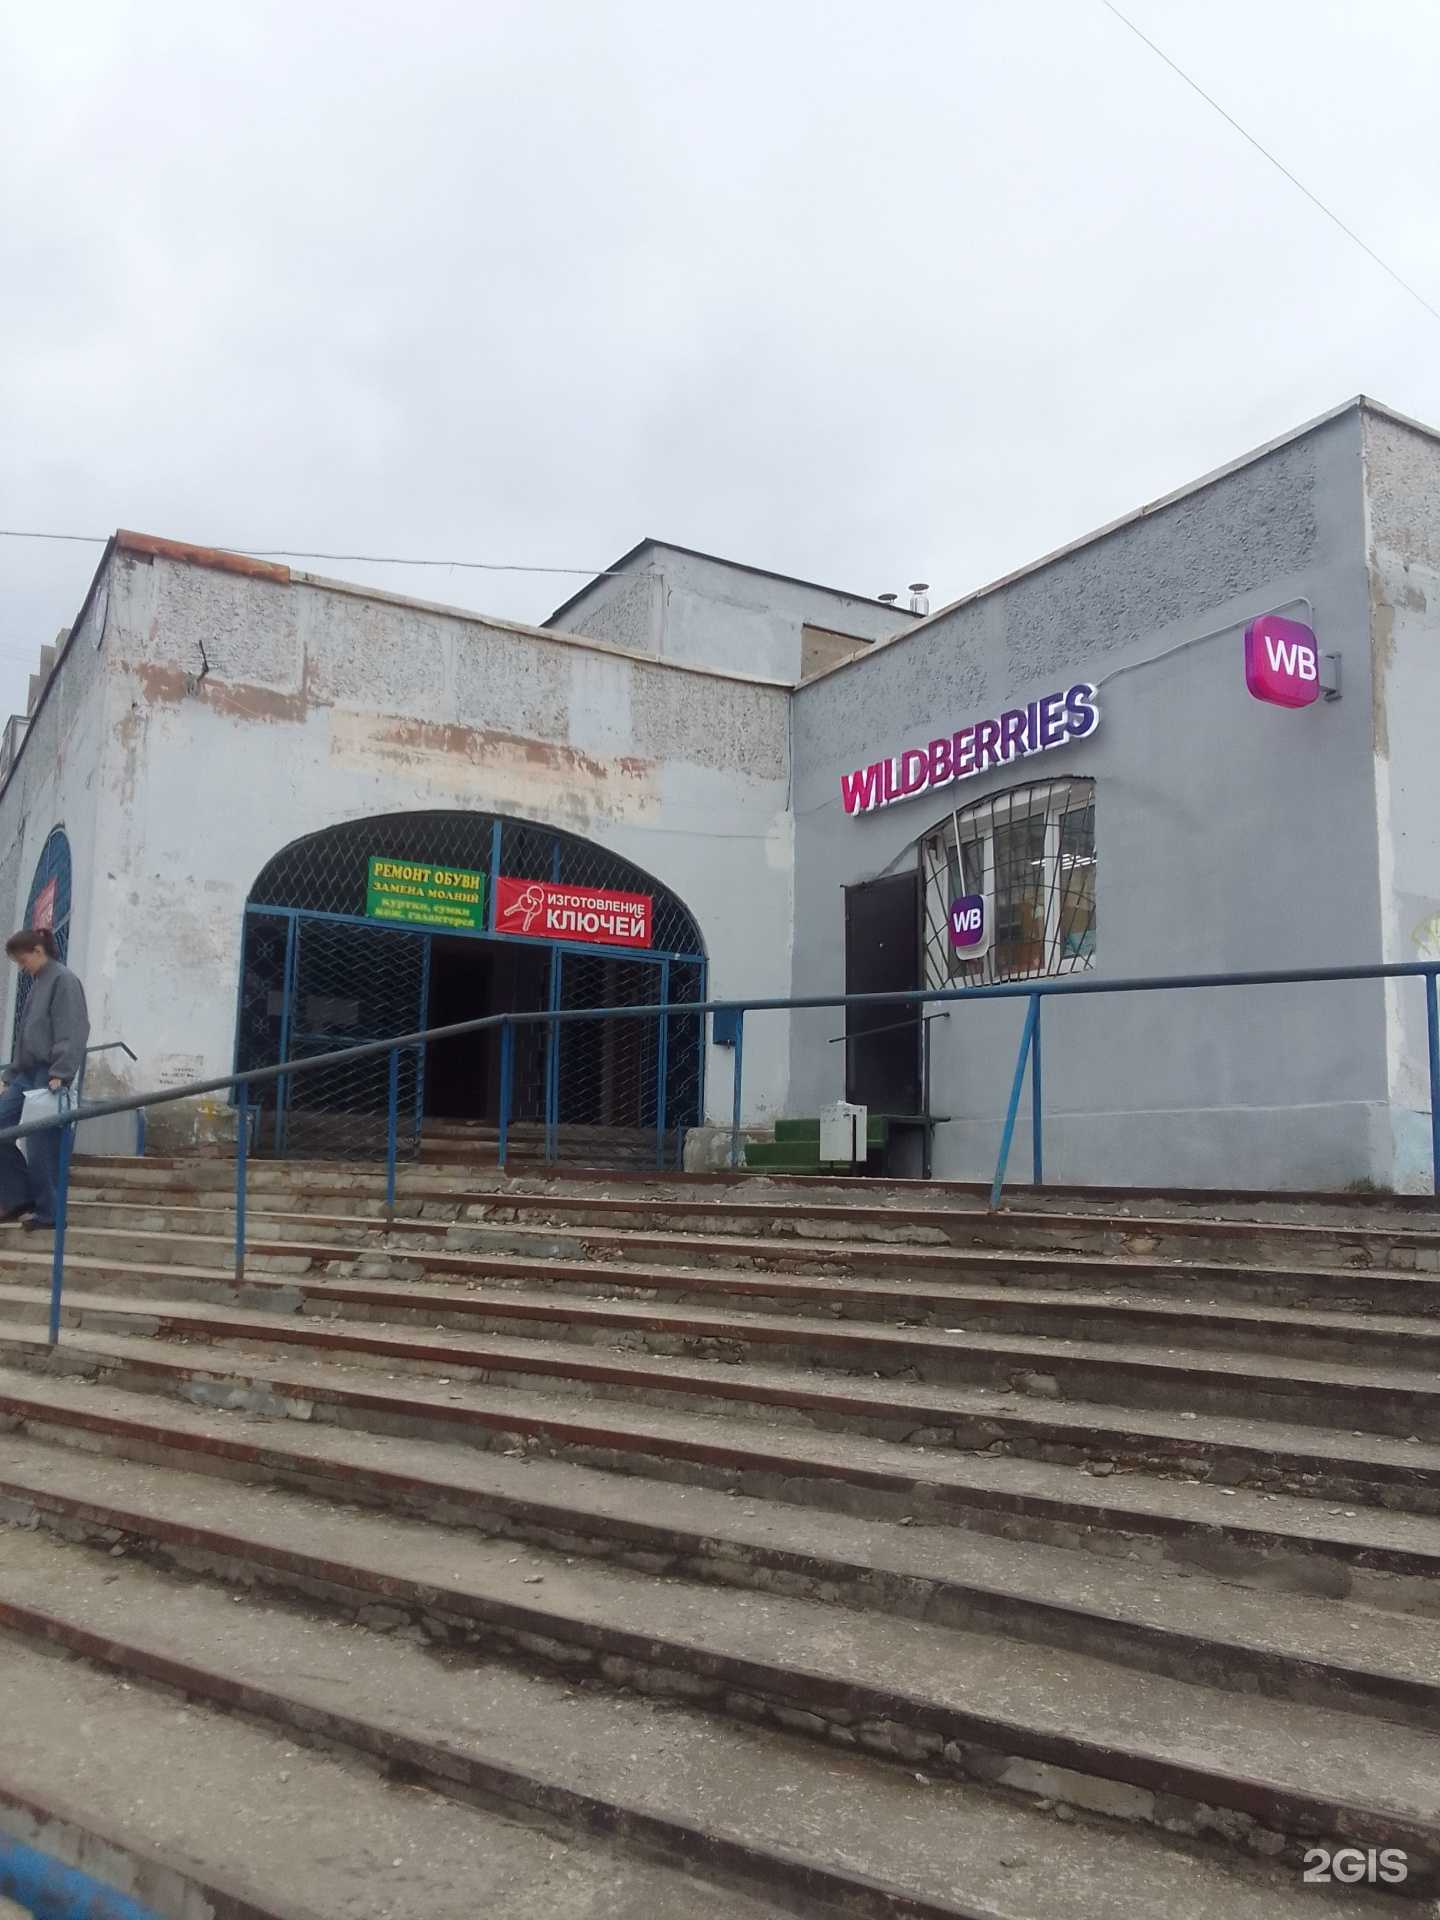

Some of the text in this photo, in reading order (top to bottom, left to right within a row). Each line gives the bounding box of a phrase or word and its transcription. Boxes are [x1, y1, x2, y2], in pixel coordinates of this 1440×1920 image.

[1264, 635, 1317, 681] WB
[840, 682, 1099, 816] WILDBERRIES
[374, 863, 480, 890] РЕМОНТ ОБУВИ
[373, 881, 480, 903] ЗАМЕНА МОЛНИЙ
[547, 893, 645, 915] ИЗГОТОВЛЕНИЕ
[547, 909, 645, 938] КЛЮЧЕЙ
[952, 907, 982, 933] WB
